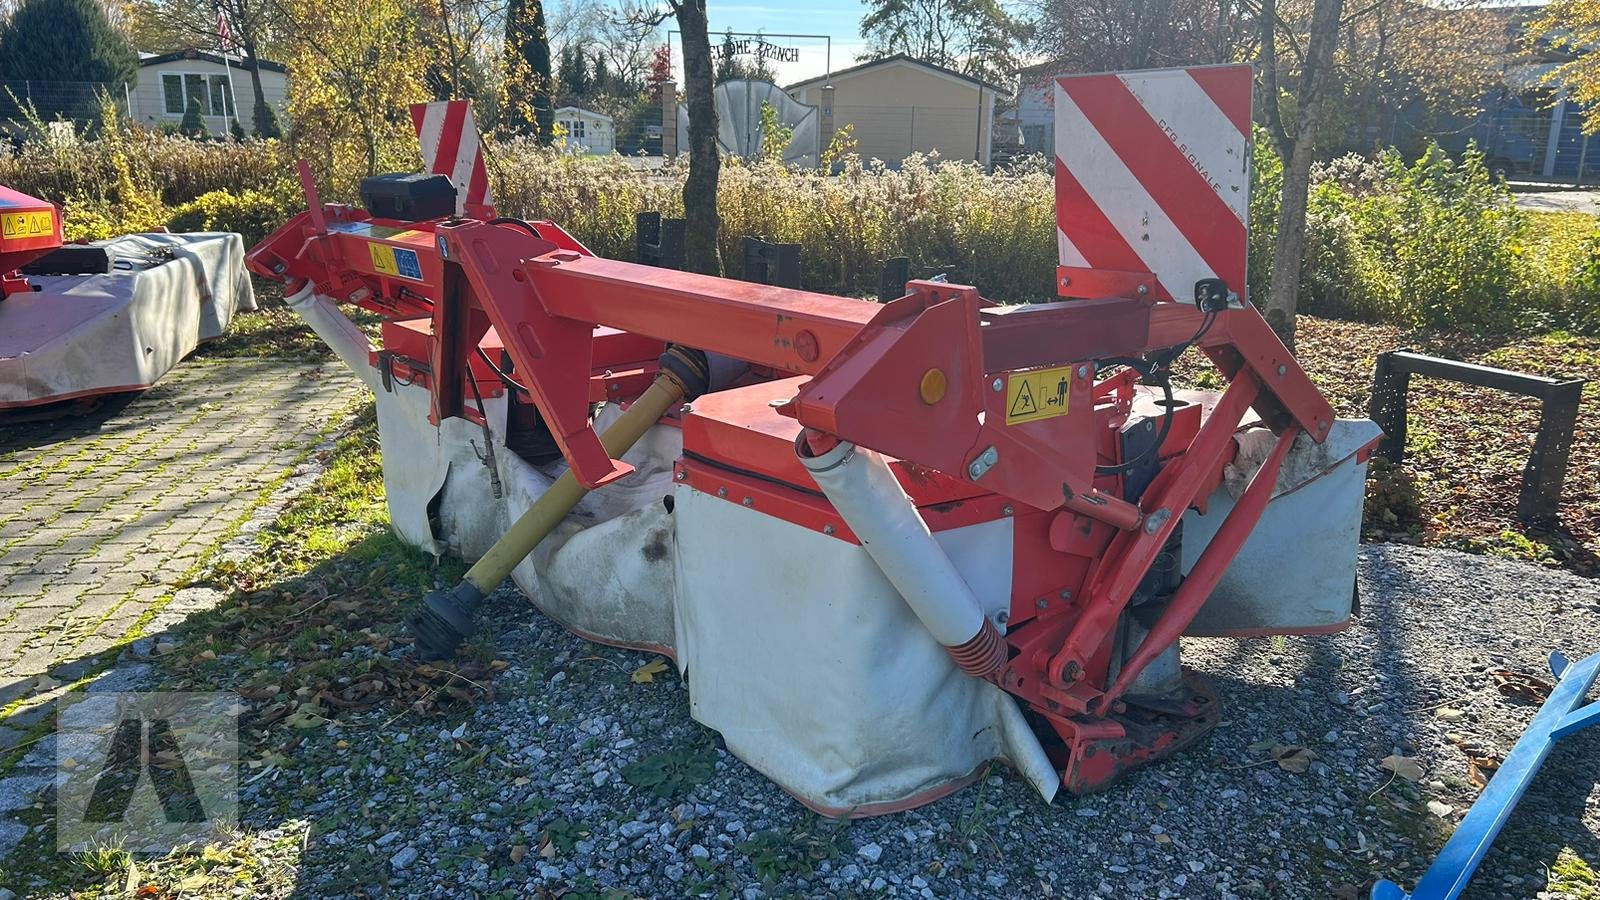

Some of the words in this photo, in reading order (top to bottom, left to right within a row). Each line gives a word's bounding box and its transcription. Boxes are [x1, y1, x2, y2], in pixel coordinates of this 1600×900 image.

[709, 40, 751, 60] ELOME
[1158, 119, 1178, 142] CFG
[1179, 143, 1222, 192] SGNALE
